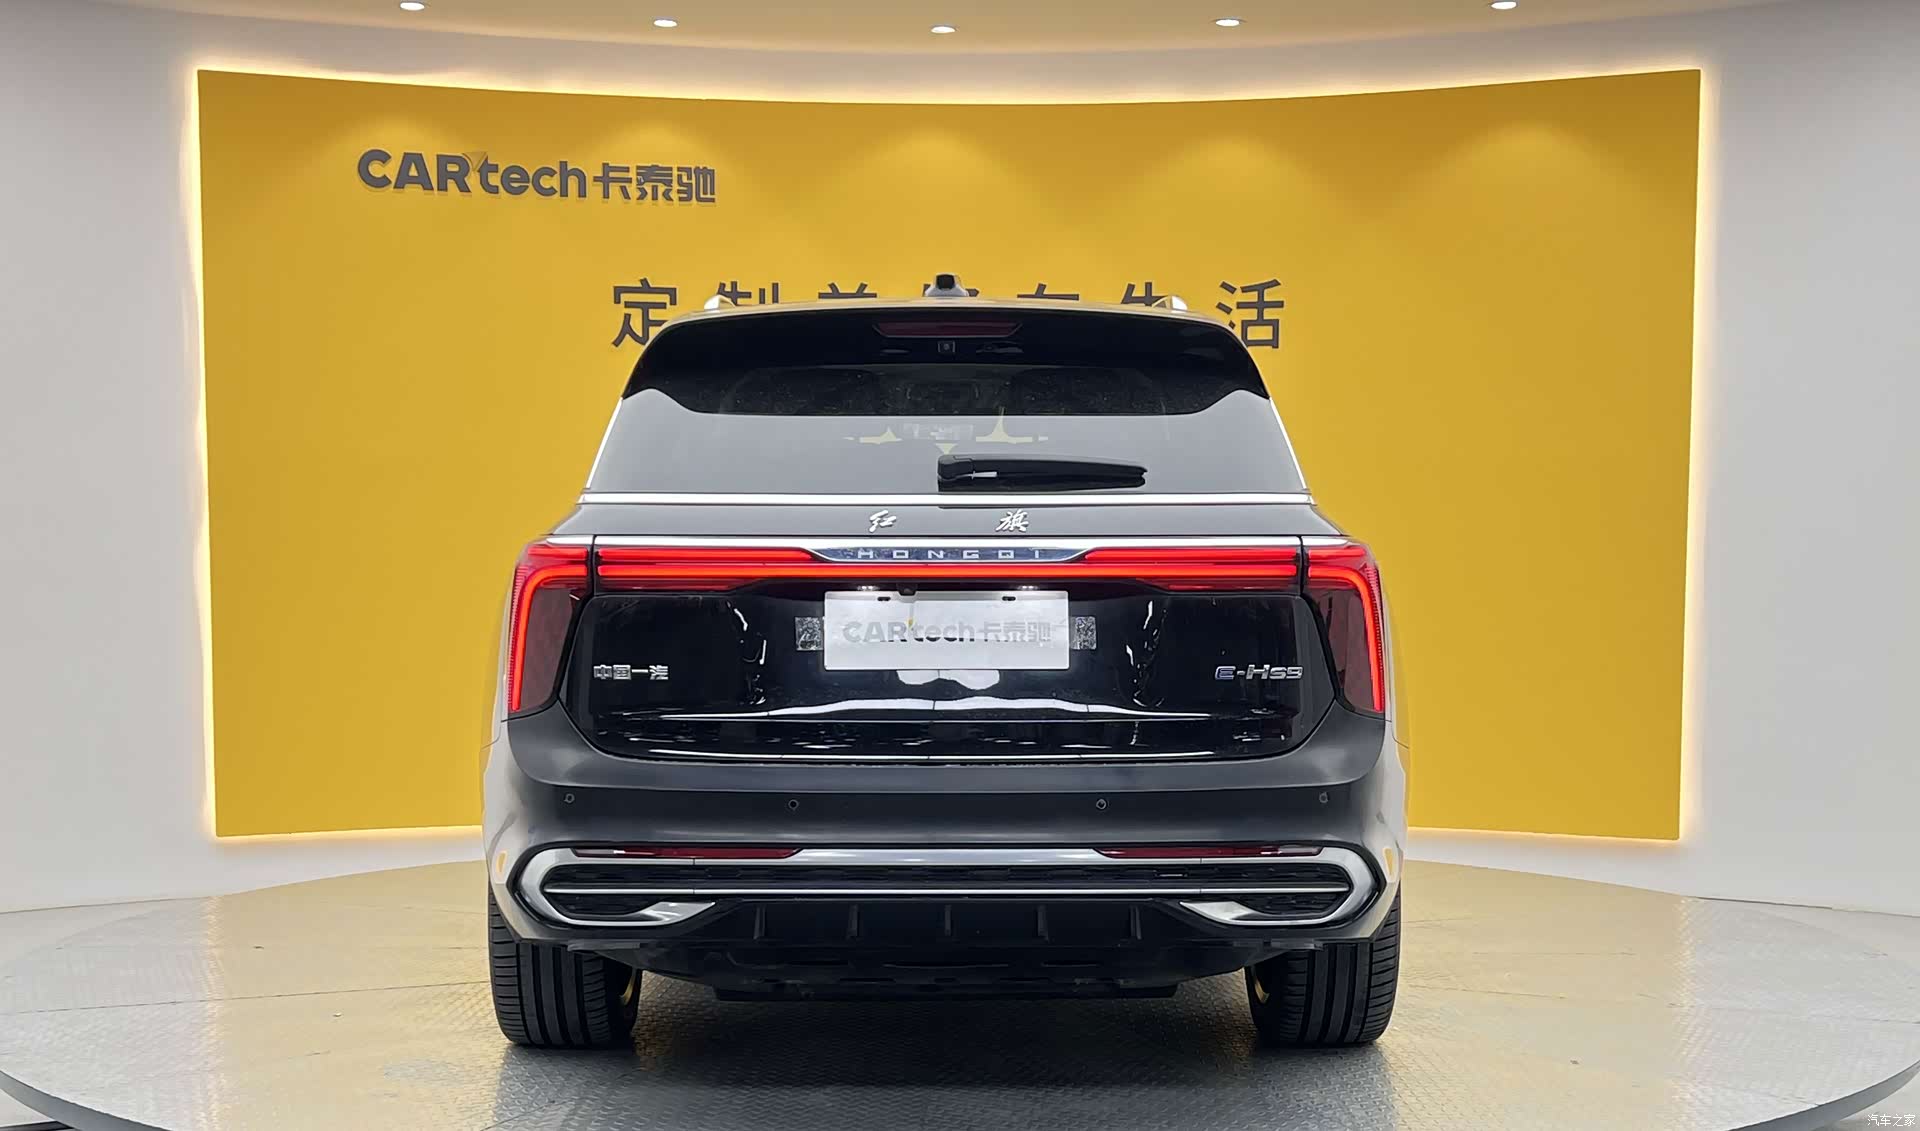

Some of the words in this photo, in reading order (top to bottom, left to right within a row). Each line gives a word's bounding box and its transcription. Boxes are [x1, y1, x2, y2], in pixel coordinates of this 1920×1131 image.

[357, 149, 587, 198] CARtech
[593, 162, 716, 203] 卡泰驰
[857, 550, 1039, 559] HONGQI
[593, 664, 669, 680] 中国一汽
